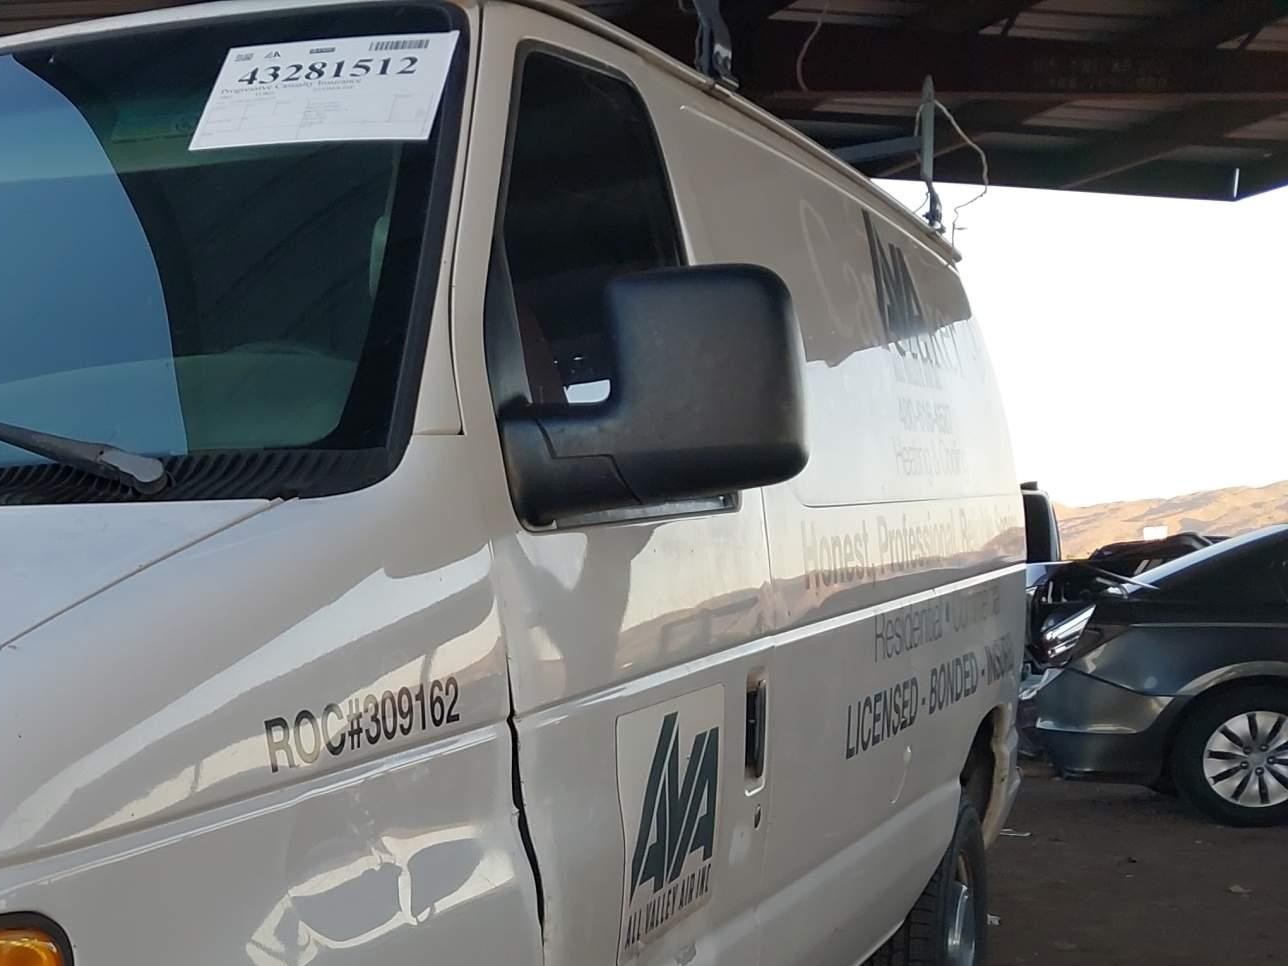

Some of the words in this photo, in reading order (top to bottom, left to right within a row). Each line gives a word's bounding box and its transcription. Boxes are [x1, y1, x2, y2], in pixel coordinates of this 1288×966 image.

[237, 56, 419, 86] 43281512
[263, 675, 461, 774] ROC#309162
[845, 676, 920, 760] LICENSED
[928, 651, 979, 716] BONDED
[624, 908, 642, 950] ALL
[644, 883, 680, 935] VALLEY
[678, 872, 696, 911] AIR
[695, 862, 712, 898] INC
